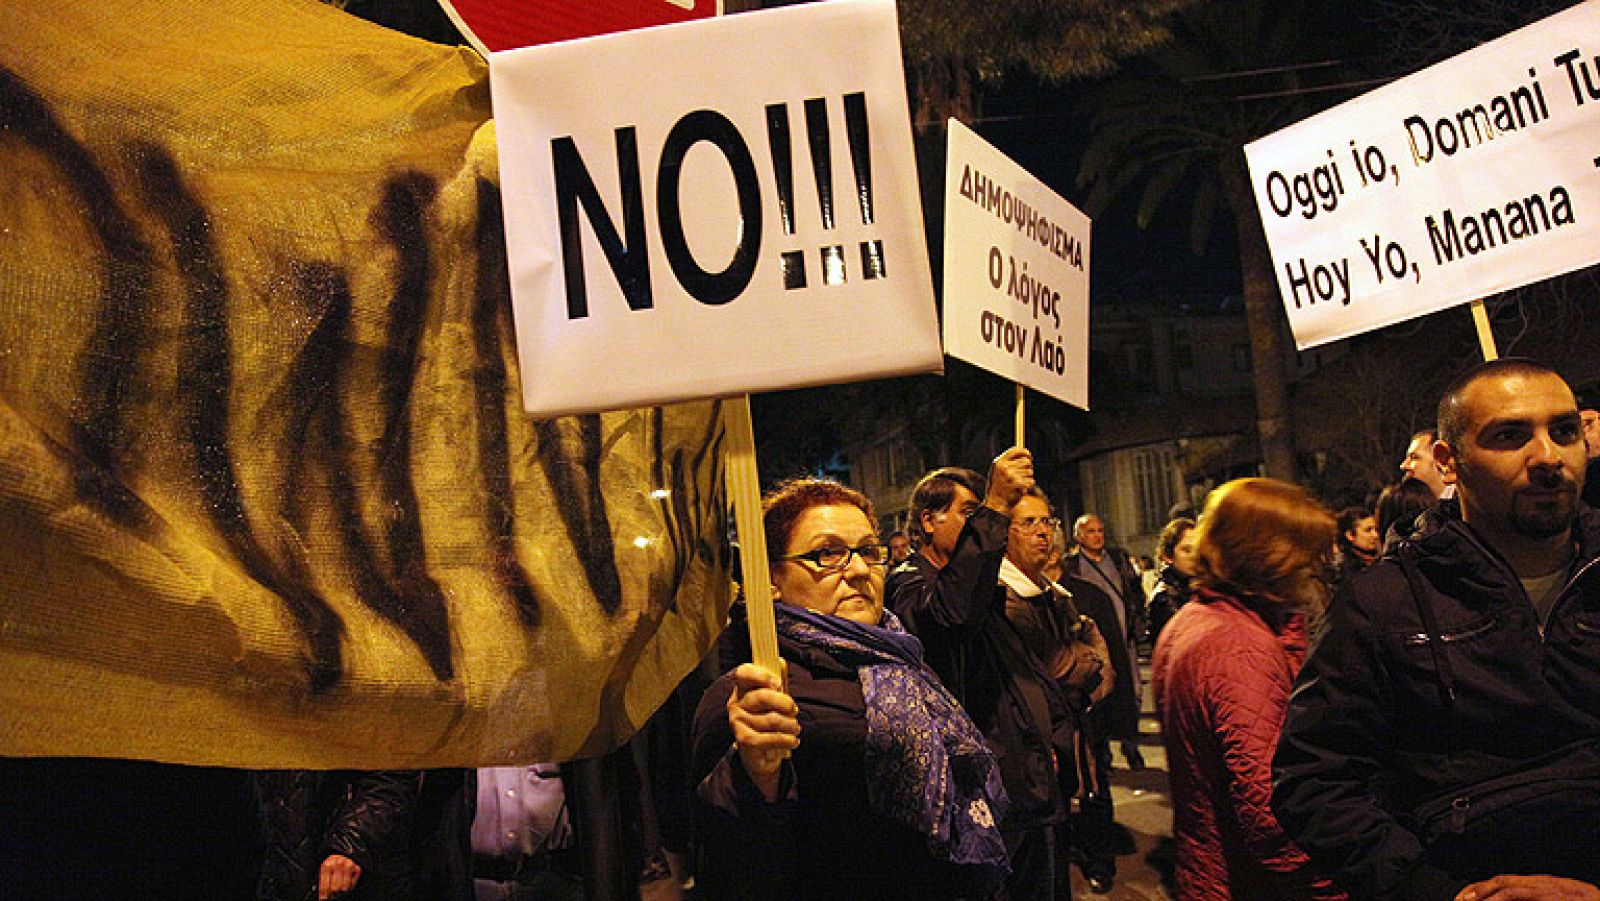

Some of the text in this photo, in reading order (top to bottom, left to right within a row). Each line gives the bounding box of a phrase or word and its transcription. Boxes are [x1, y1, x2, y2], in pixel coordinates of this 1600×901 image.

[1266, 149, 1345, 220] Oggi
[1350, 140, 1399, 187] io,
[1404, 67, 1549, 167] Domani
[551, 91, 887, 320] NO!!!
[959, 164, 1084, 272] ΔΗΜΟΨΗΦΙΣΜΑ
[1285, 186, 1576, 309] Hoy Yo, Manana
[981, 310, 1066, 377] στον Λαό
[1007, 255, 1061, 330] λόγος
